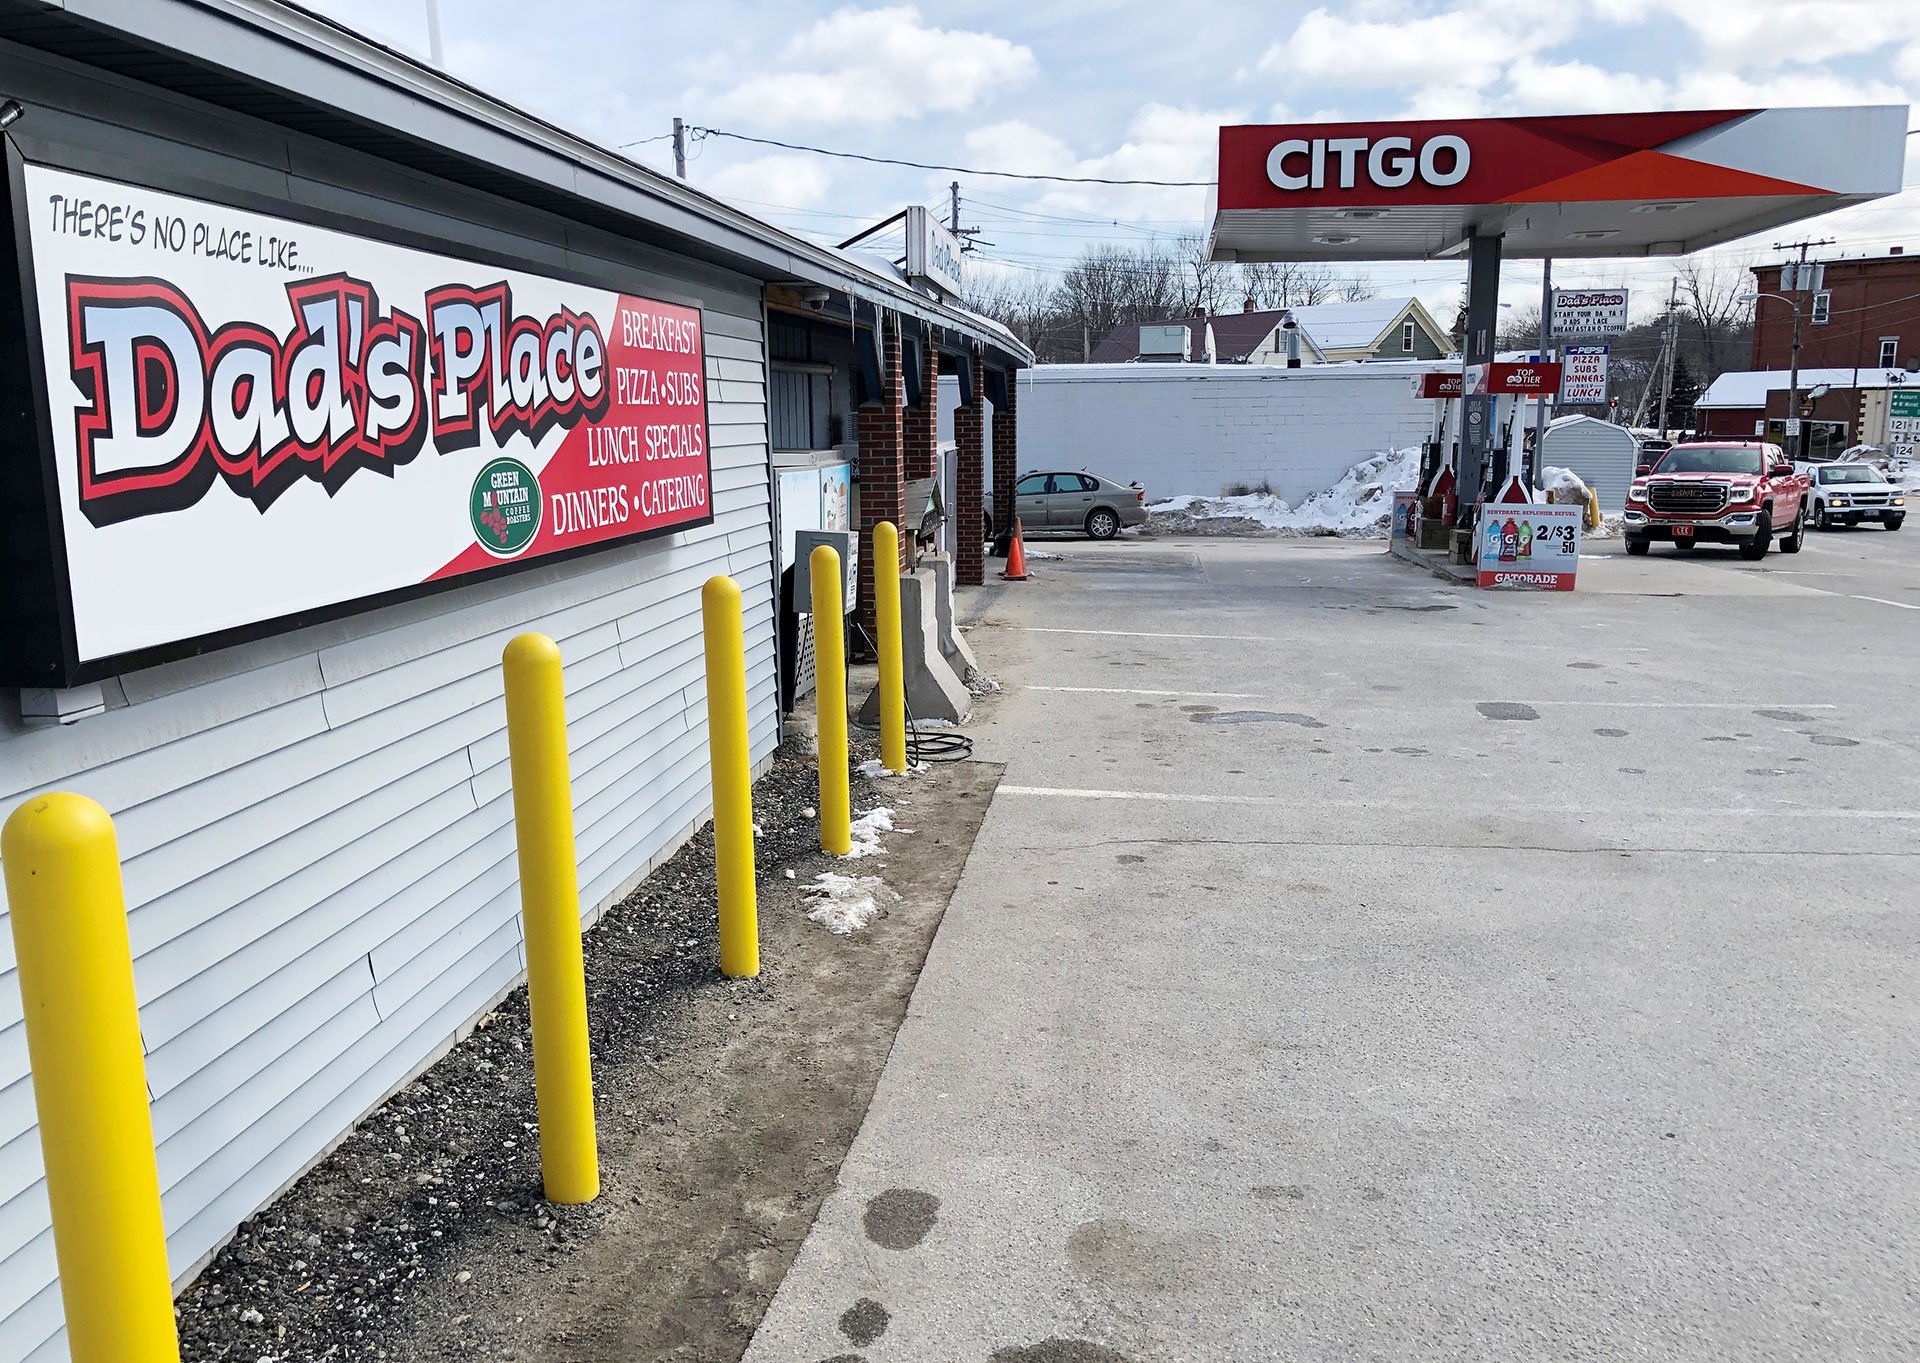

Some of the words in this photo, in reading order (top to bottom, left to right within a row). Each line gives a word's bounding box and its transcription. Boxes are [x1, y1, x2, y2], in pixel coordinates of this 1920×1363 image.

[1266, 134, 1470, 190] CITGO
[50, 194, 146, 245] THERE'S
[154, 215, 186, 253] NO
[193, 222, 252, 264] PLACE
[1557, 294, 1590, 308] Dad's
[1590, 293, 1623, 307] Place
[621, 309, 697, 355] BREAKFAST
[1577, 346, 1605, 354] PEPSI
[1572, 355, 1600, 363] PIZZA
[1516, 368, 1534, 376] TOP
[1574, 365, 1598, 373] SUBS
[1522, 375, 1541, 384] TIER
[1566, 374, 1605, 383] DINNERS
[616, 367, 660, 405] PIZZA
[666, 371, 700, 406] SUBS
[66, 272, 428, 522] Dad's
[425, 281, 608, 452] Place
[1567, 388, 1602, 397] LUNCH
[1891, 420, 1907, 430] 121
[587, 426, 641, 468] LUNCH
[645, 423, 703, 462] SPECIALS
[1895, 446, 1913, 456] 124
[491, 471, 519, 489] GREEN
[505, 505, 531, 516] COFFEE
[551, 484, 630, 537] DINNERS
[641, 474, 706, 518] CATERING
[506, 513, 532, 525] ROASTERS
[1676, 527, 1689, 535] LEE
[1562, 541, 1575, 553] 50
[1495, 573, 1558, 584] GATORADE
